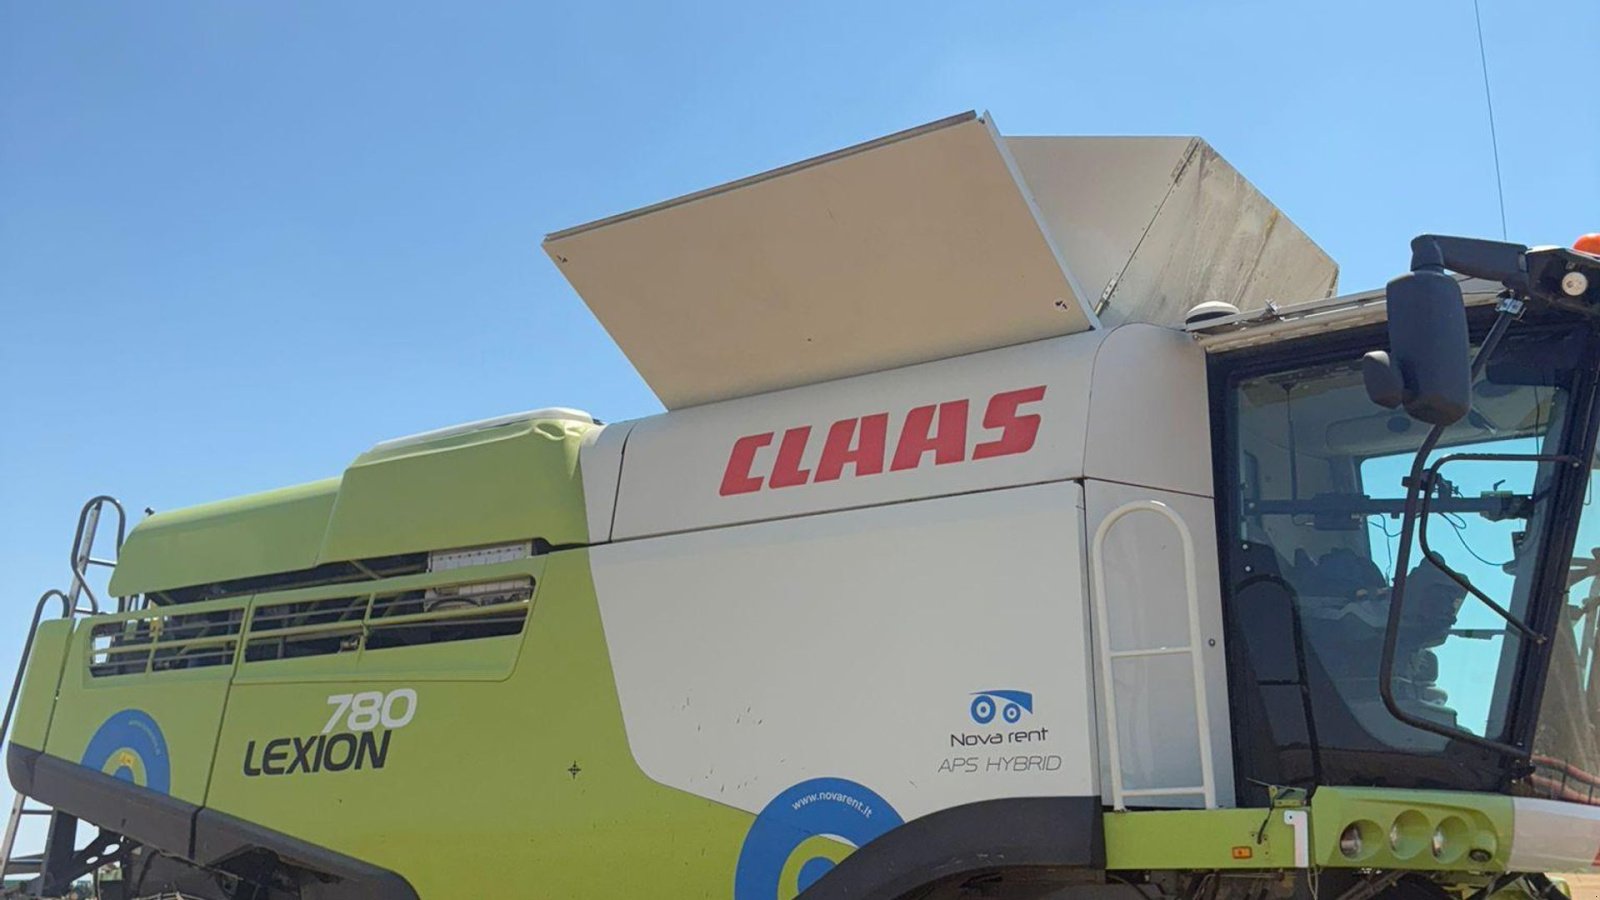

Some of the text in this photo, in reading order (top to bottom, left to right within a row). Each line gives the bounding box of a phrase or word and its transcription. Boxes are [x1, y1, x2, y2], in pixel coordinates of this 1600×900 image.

[719, 385, 1047, 497] CLAAS
[321, 688, 418, 734] 780
[243, 729, 392, 777] LEXION
[950, 727, 1049, 748] Nova rent
[937, 754, 1062, 773] APS HYBRID
[791, 791, 873, 819] www.novarent.it
